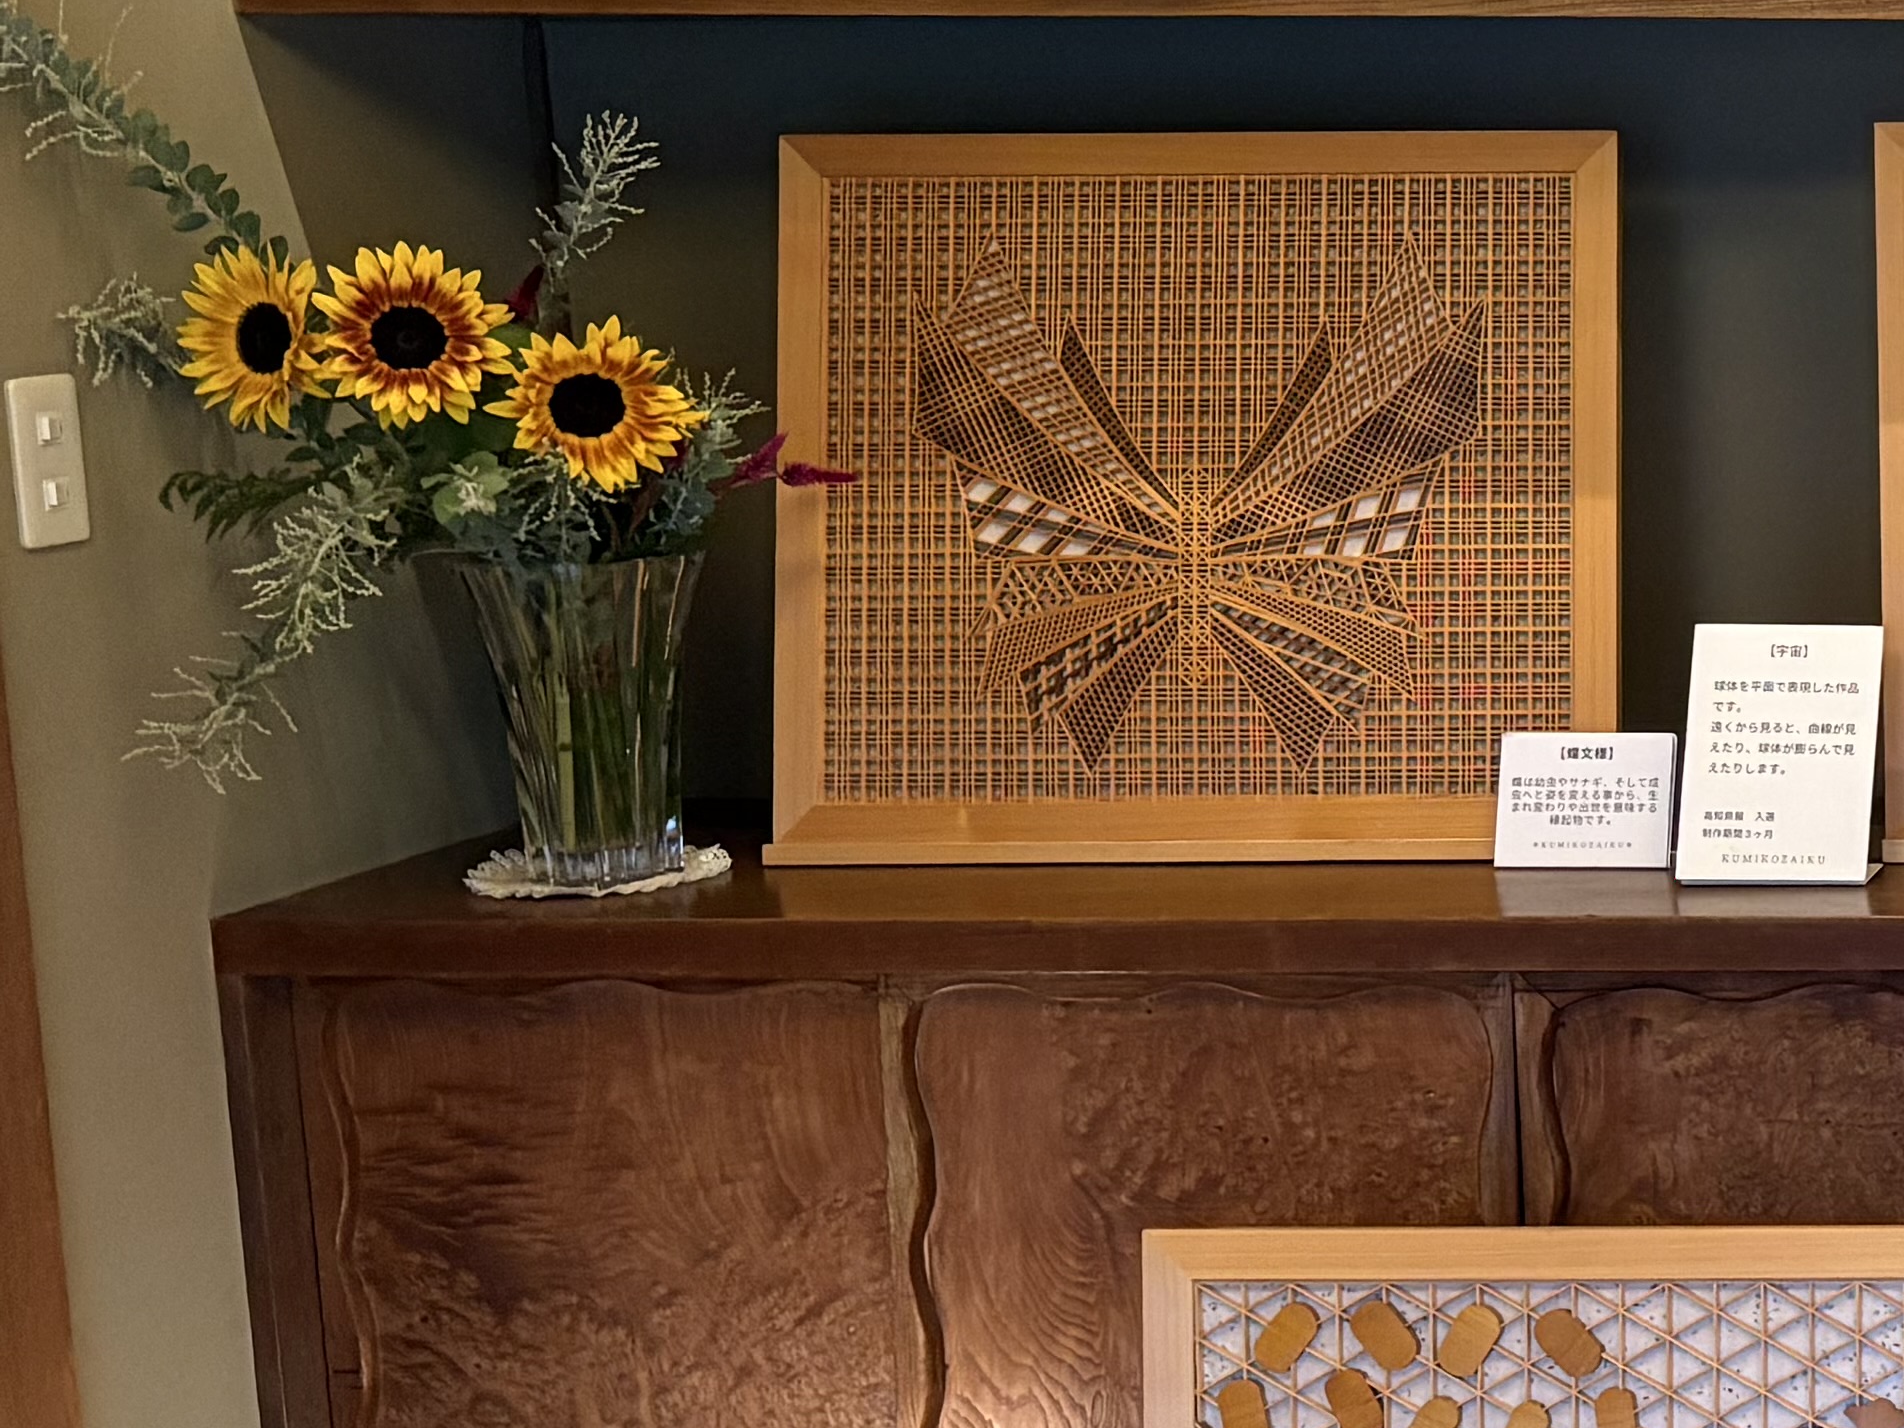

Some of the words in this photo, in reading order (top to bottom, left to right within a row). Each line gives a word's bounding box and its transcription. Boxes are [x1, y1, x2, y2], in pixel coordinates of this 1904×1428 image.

[1770, 644, 1809, 658] 【宇宙】
[1713, 701, 1741, 713] です。
[1708, 762, 1786, 775] えたりします。
[1722, 854, 1826, 864] KUMIKOZAIKU
